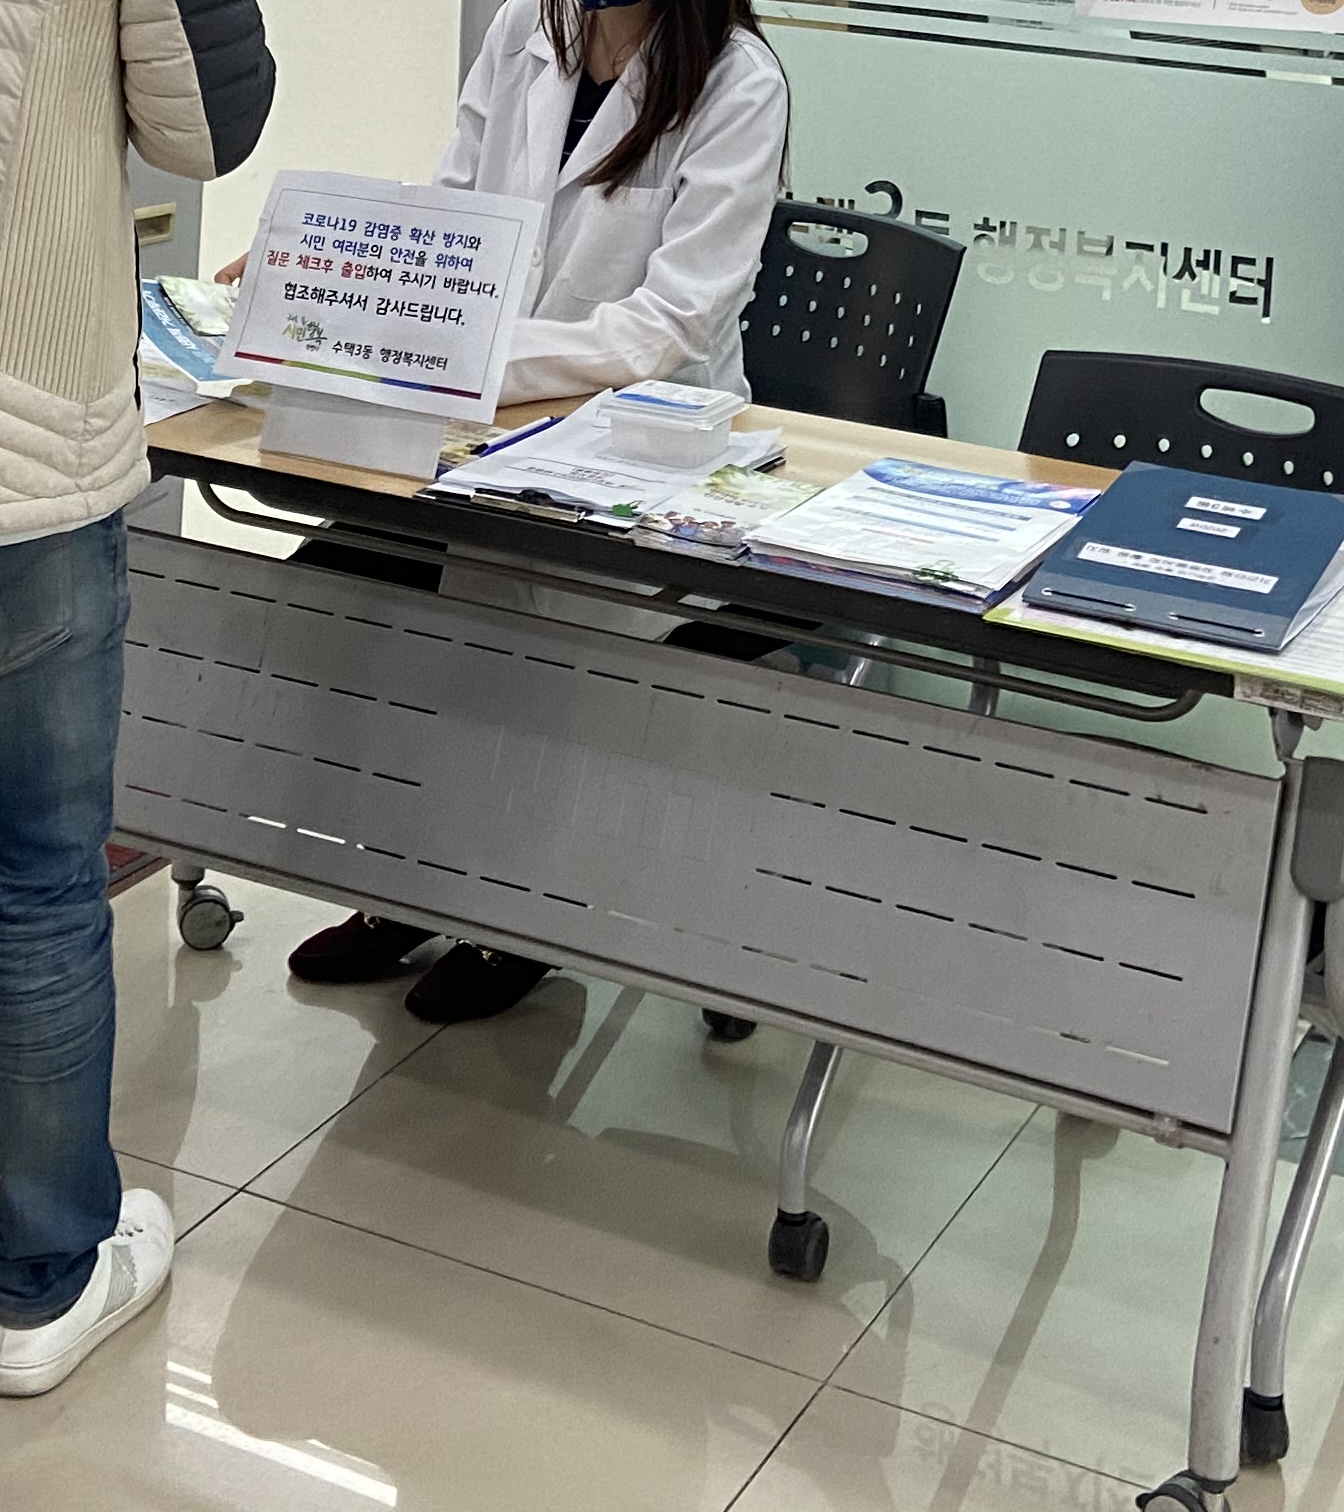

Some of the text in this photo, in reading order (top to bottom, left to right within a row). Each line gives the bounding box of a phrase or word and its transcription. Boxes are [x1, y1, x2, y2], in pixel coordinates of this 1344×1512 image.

[300, 233, 474, 272] 시민 여러분의 안전을 위하여
[301, 212, 482, 251] 코로나19 감염증 확산 방지와
[296, 253, 334, 274] 체크후
[341, 261, 393, 283] 출입하여
[398, 270, 436, 290] 주시기
[443, 276, 499, 299] 바랍니다.
[973, 216, 1275, 324] 행정복지센터
[284, 281, 466, 326] 협조해주셔서 감사드립니다.
[331, 340, 449, 371] 수택3동 행정복지센터
